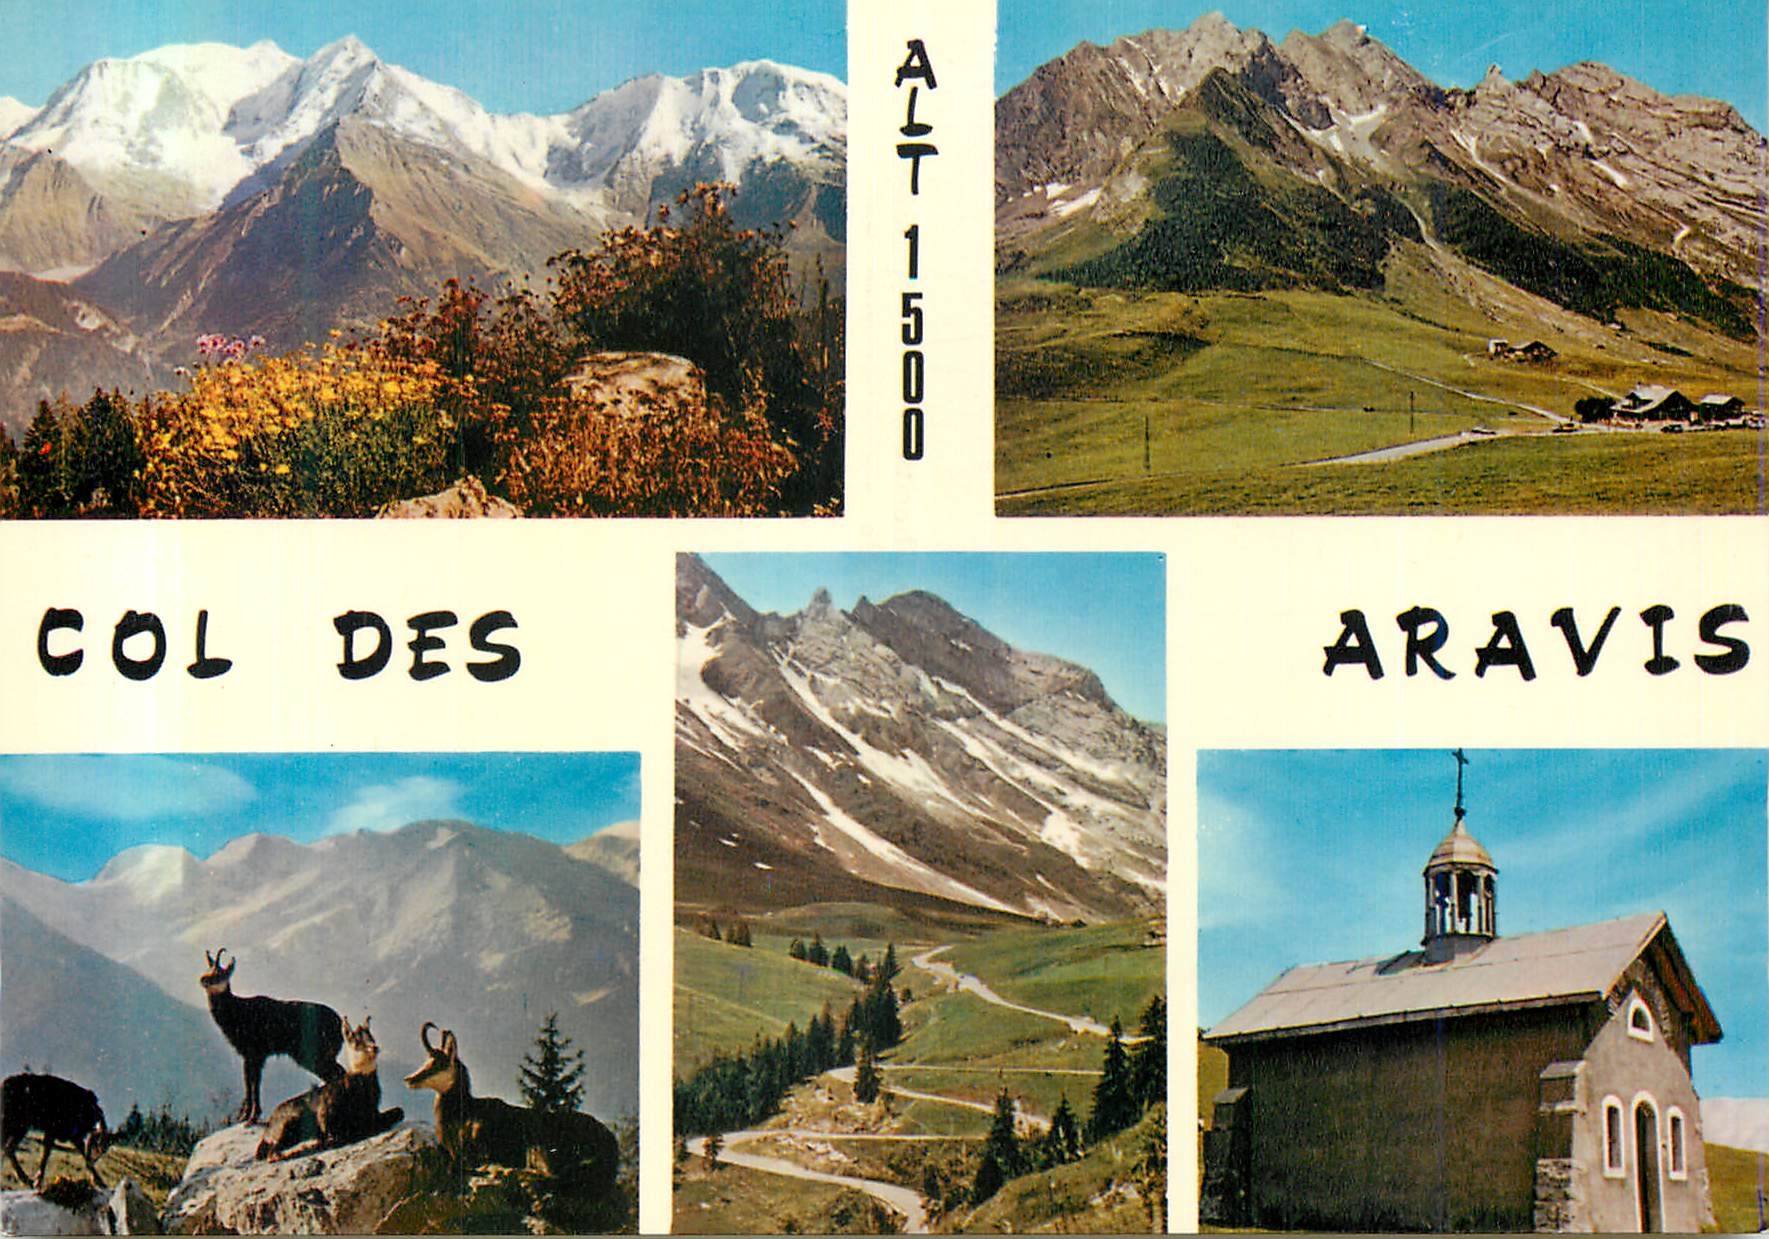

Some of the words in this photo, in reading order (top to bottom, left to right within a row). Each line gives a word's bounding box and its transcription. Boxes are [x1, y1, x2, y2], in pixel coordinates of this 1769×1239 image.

[894, 39, 939, 196] ALT
[901, 224, 924, 461] 1500
[37, 607, 233, 681] COL
[333, 610, 521, 683] DES
[1322, 603, 1750, 682] ARAVIS
